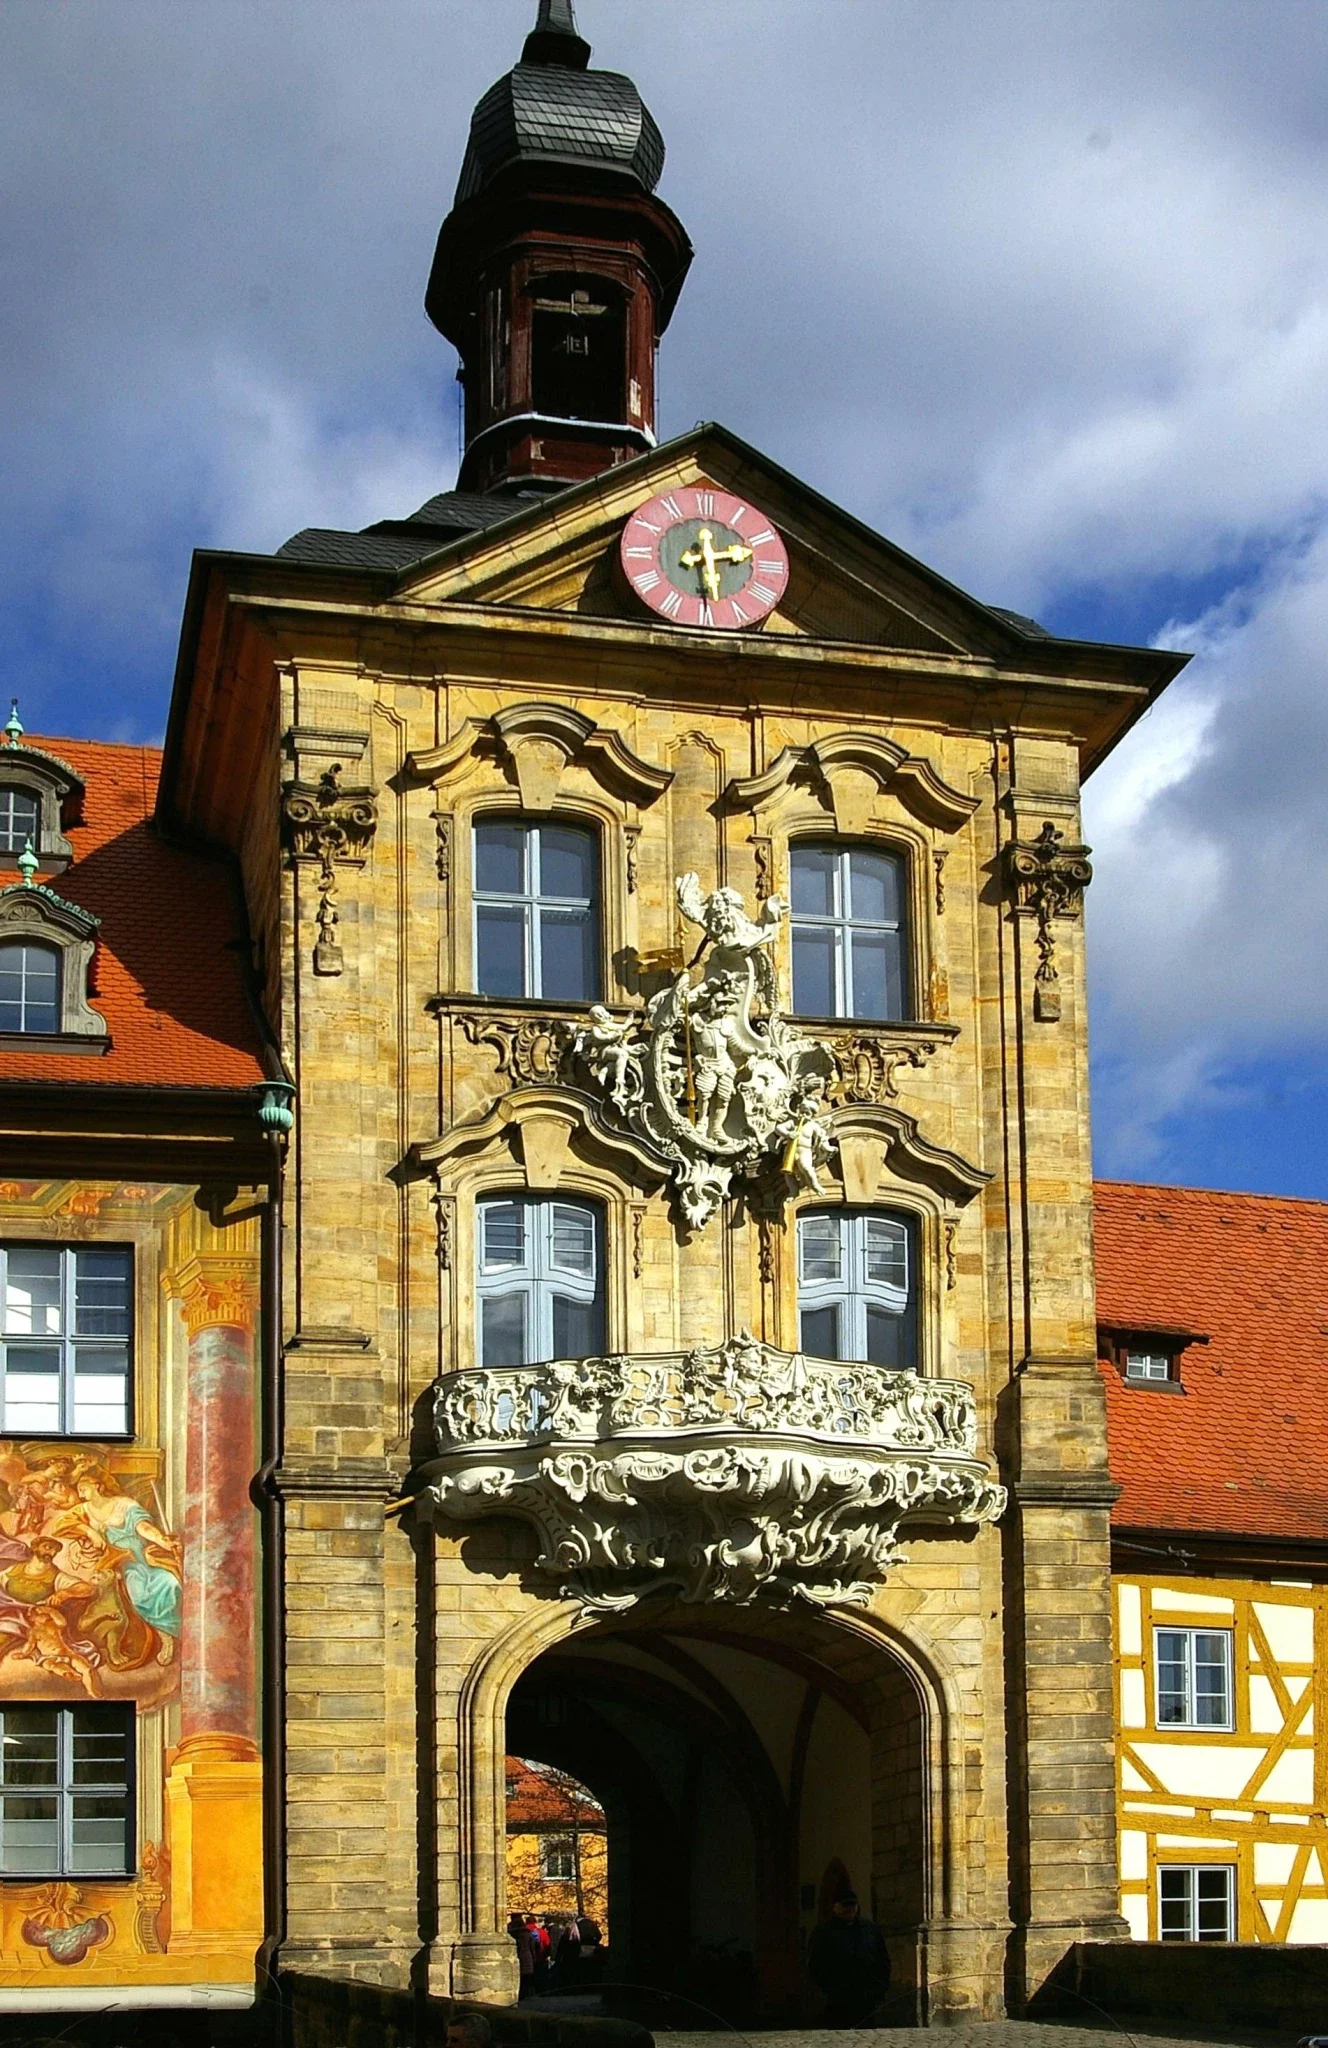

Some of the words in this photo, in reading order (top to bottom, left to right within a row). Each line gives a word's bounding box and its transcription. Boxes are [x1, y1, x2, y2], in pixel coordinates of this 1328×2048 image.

[660, 496, 683, 521] XI
[696, 493, 714, 516] XII
[730, 506, 746, 525] I
[635, 515, 662, 536] X
[748, 529, 776, 547] II
[757, 560, 784, 574] III
[633, 569, 661, 594] VIII
[660, 591, 683, 617] VII
[747, 581, 777, 606] IIII
[699, 603, 714, 626] VI
[731, 600, 750, 623] V
